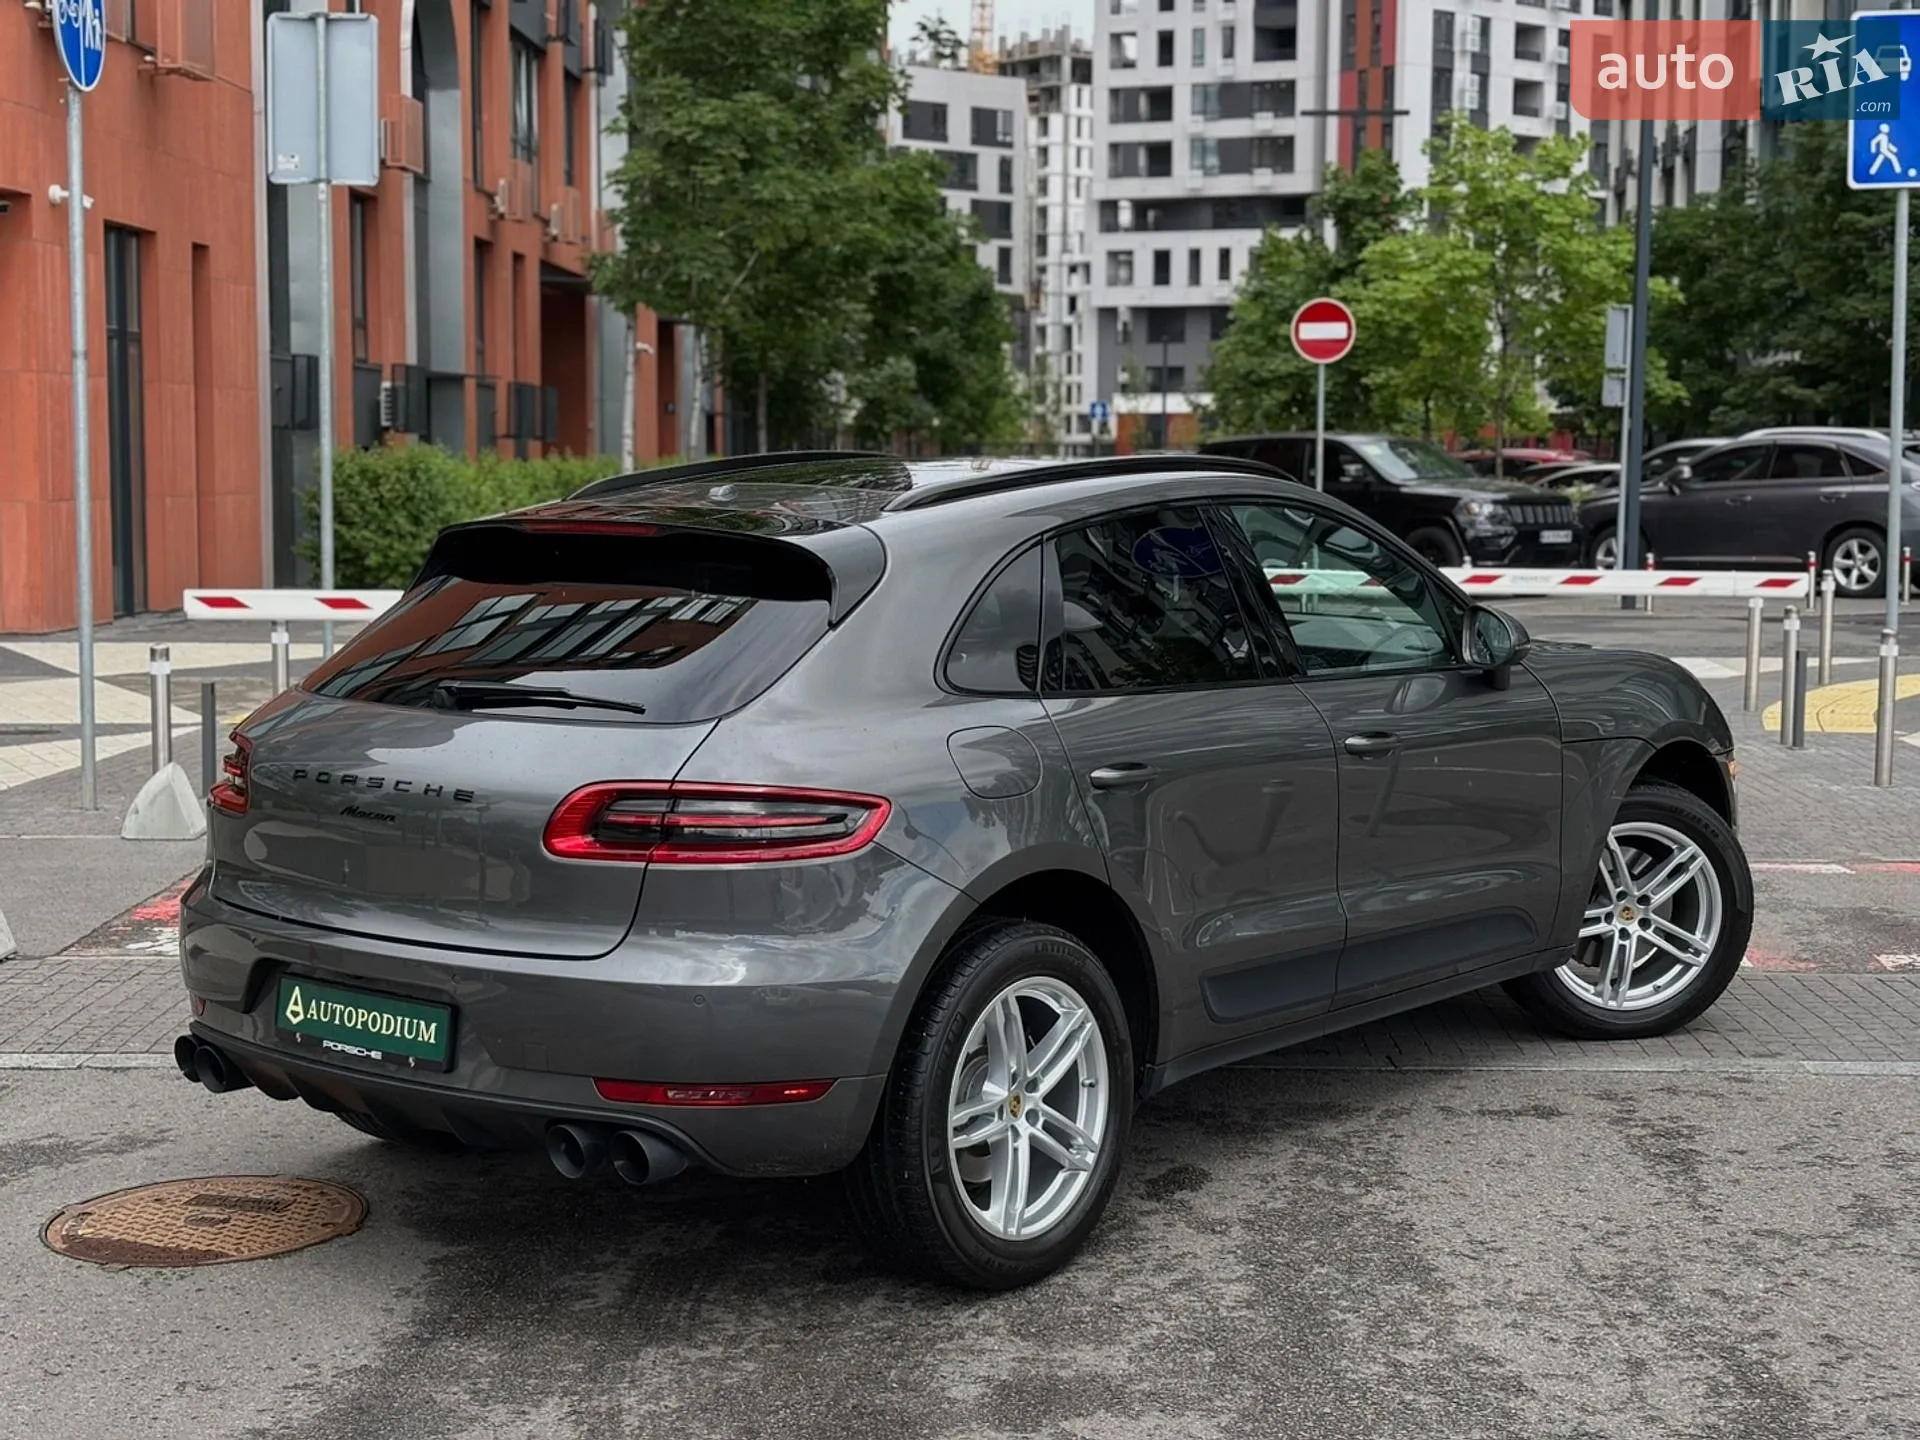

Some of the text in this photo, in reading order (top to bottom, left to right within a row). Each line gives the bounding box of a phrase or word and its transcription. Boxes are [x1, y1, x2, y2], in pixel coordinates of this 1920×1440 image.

[292, 769, 475, 803] PORSCHE
[339, 804, 396, 823] Macan
[307, 999, 438, 1044] AUTOPODIUM
[322, 1039, 383, 1060] PORSCHE
